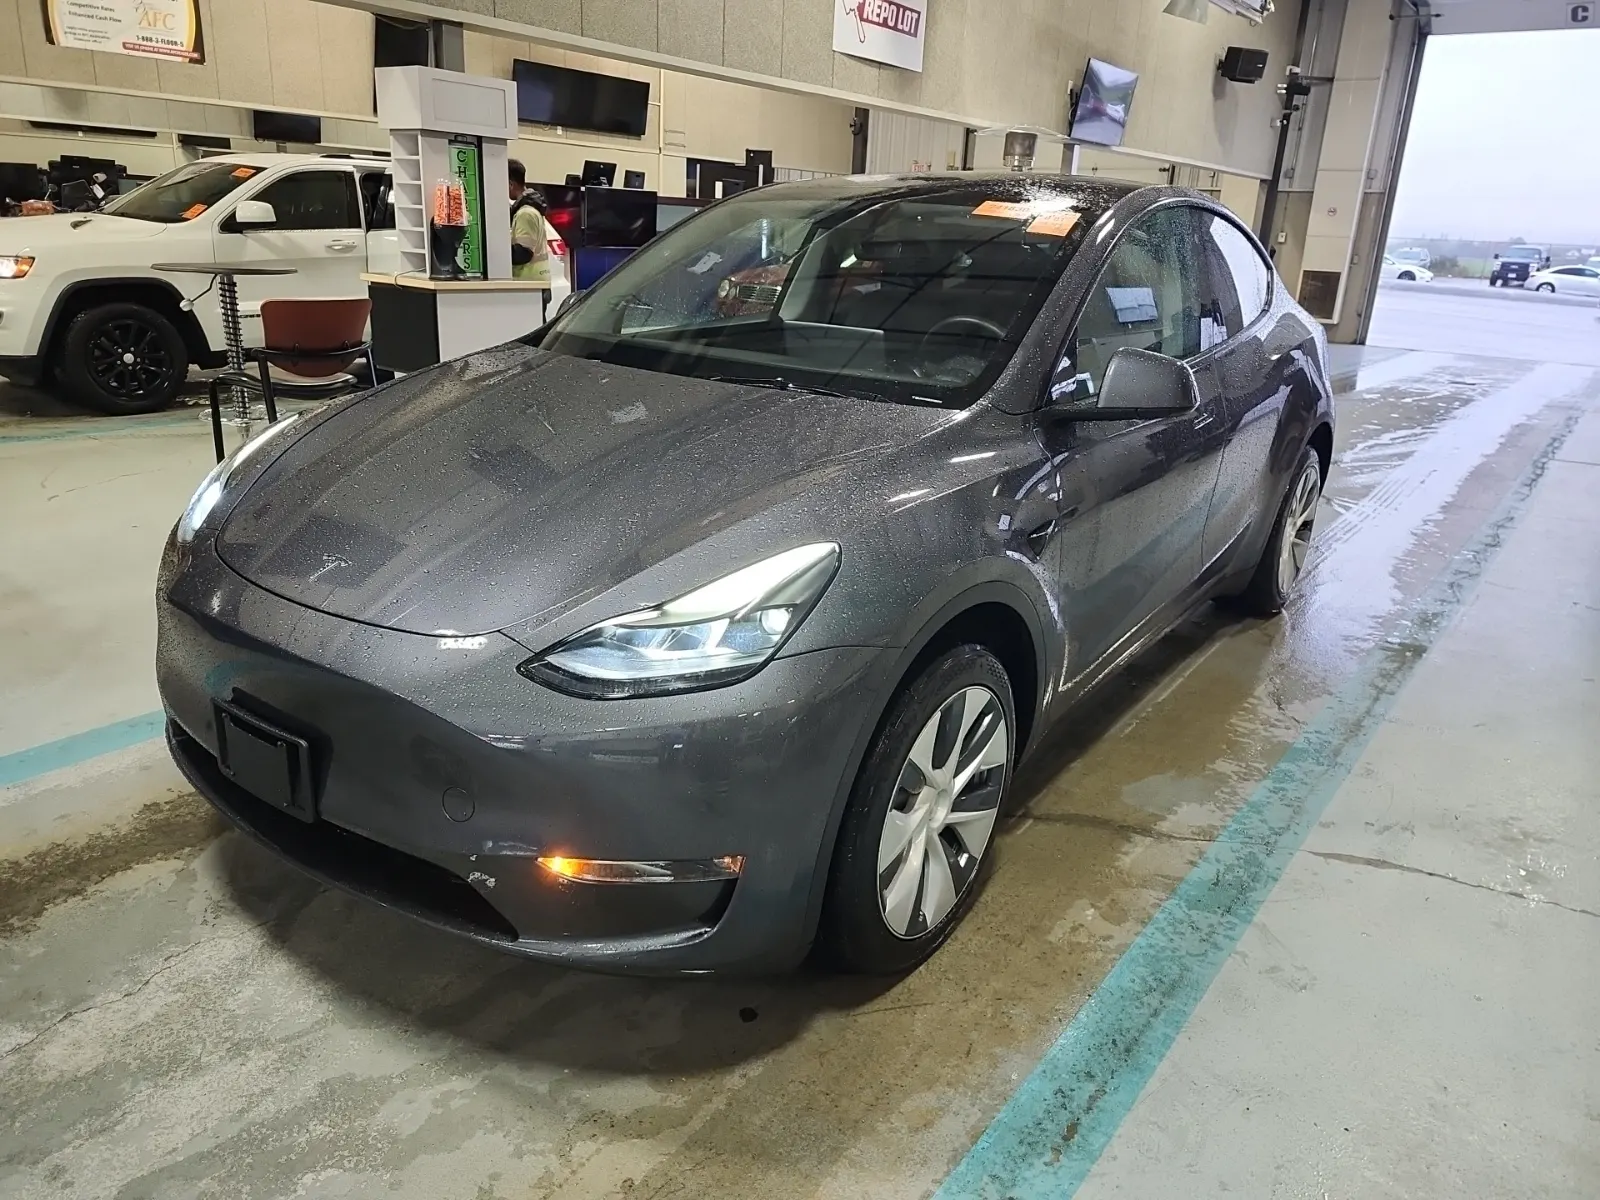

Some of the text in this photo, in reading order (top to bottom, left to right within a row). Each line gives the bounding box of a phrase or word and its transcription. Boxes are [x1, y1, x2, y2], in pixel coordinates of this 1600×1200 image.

[68, 10, 95, 19] Enhanced
[138, 10, 176, 30] AFC
[863, 0, 918, 34] REPO LOT
[1571, 5, 1589, 23] C
